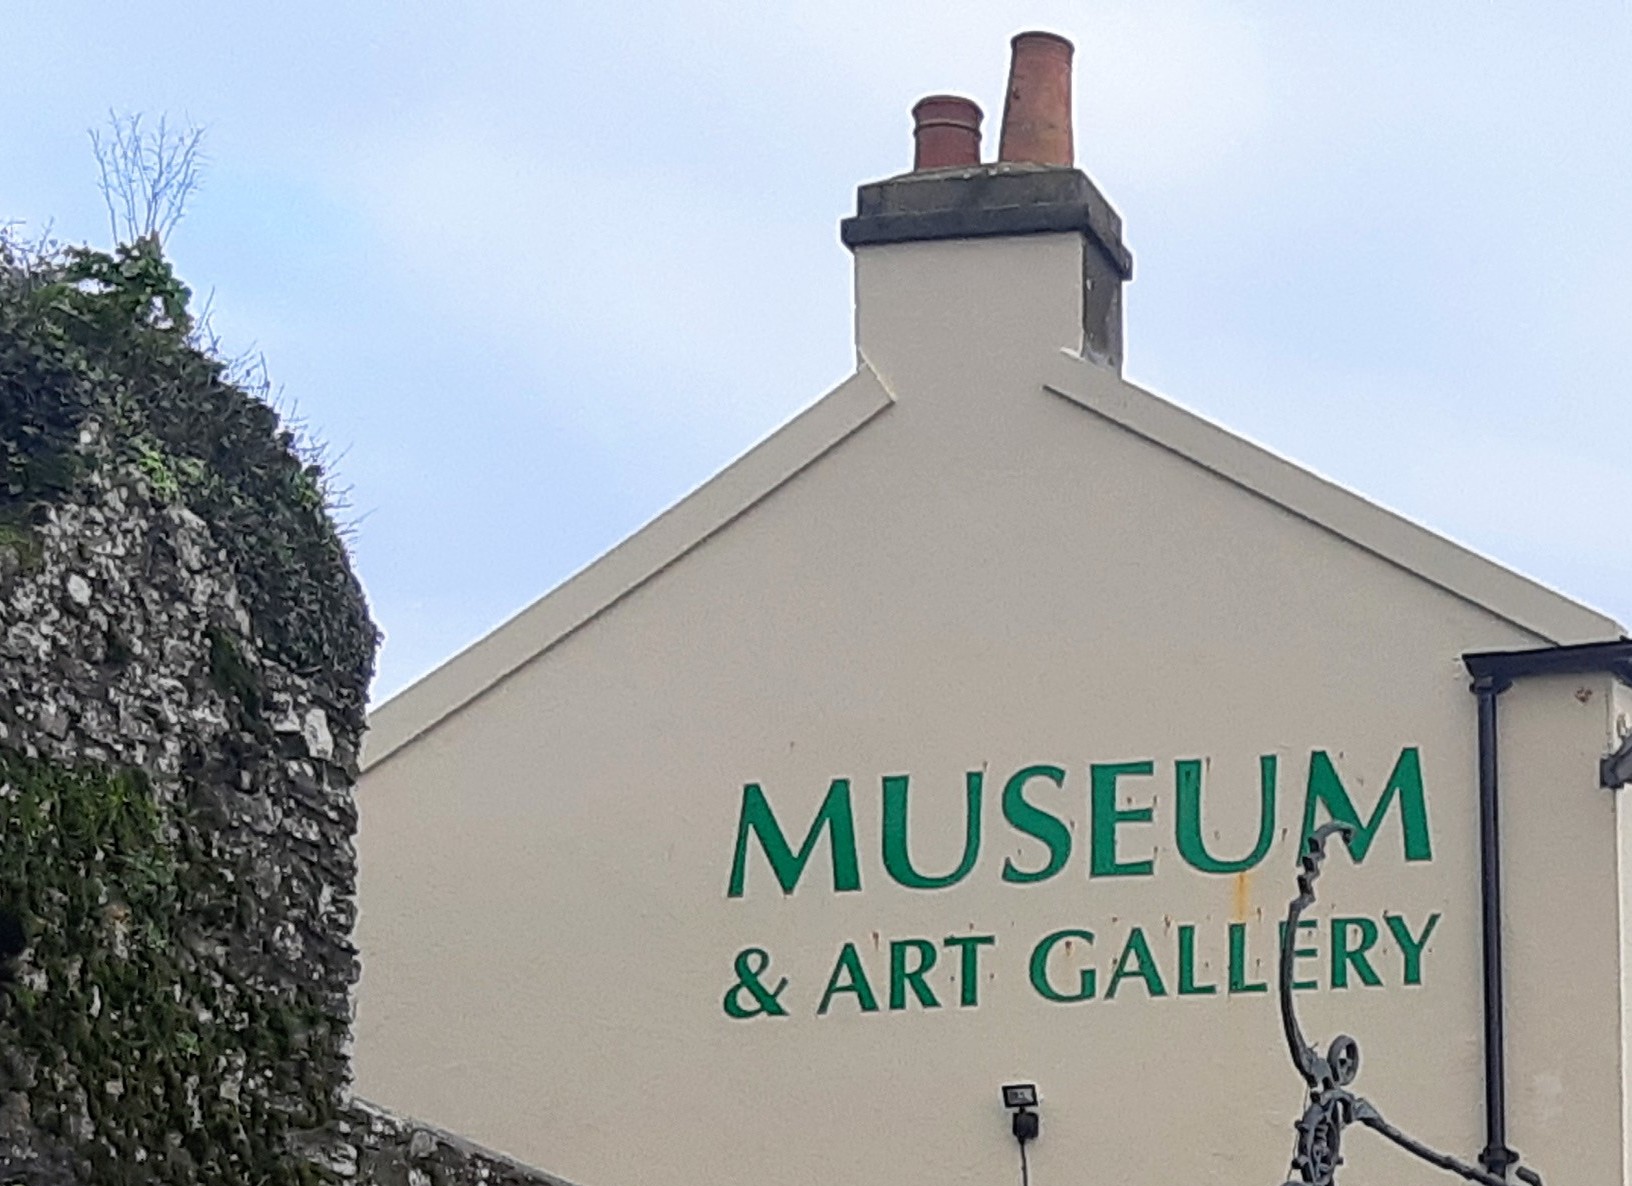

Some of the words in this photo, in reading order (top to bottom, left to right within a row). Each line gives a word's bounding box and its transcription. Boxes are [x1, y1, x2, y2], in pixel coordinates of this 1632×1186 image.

[726, 746, 1433, 898] MUSEUM
[722, 947, 789, 1018] &
[817, 934, 995, 1016] ART
[1029, 912, 1441, 1003] GALLERY
